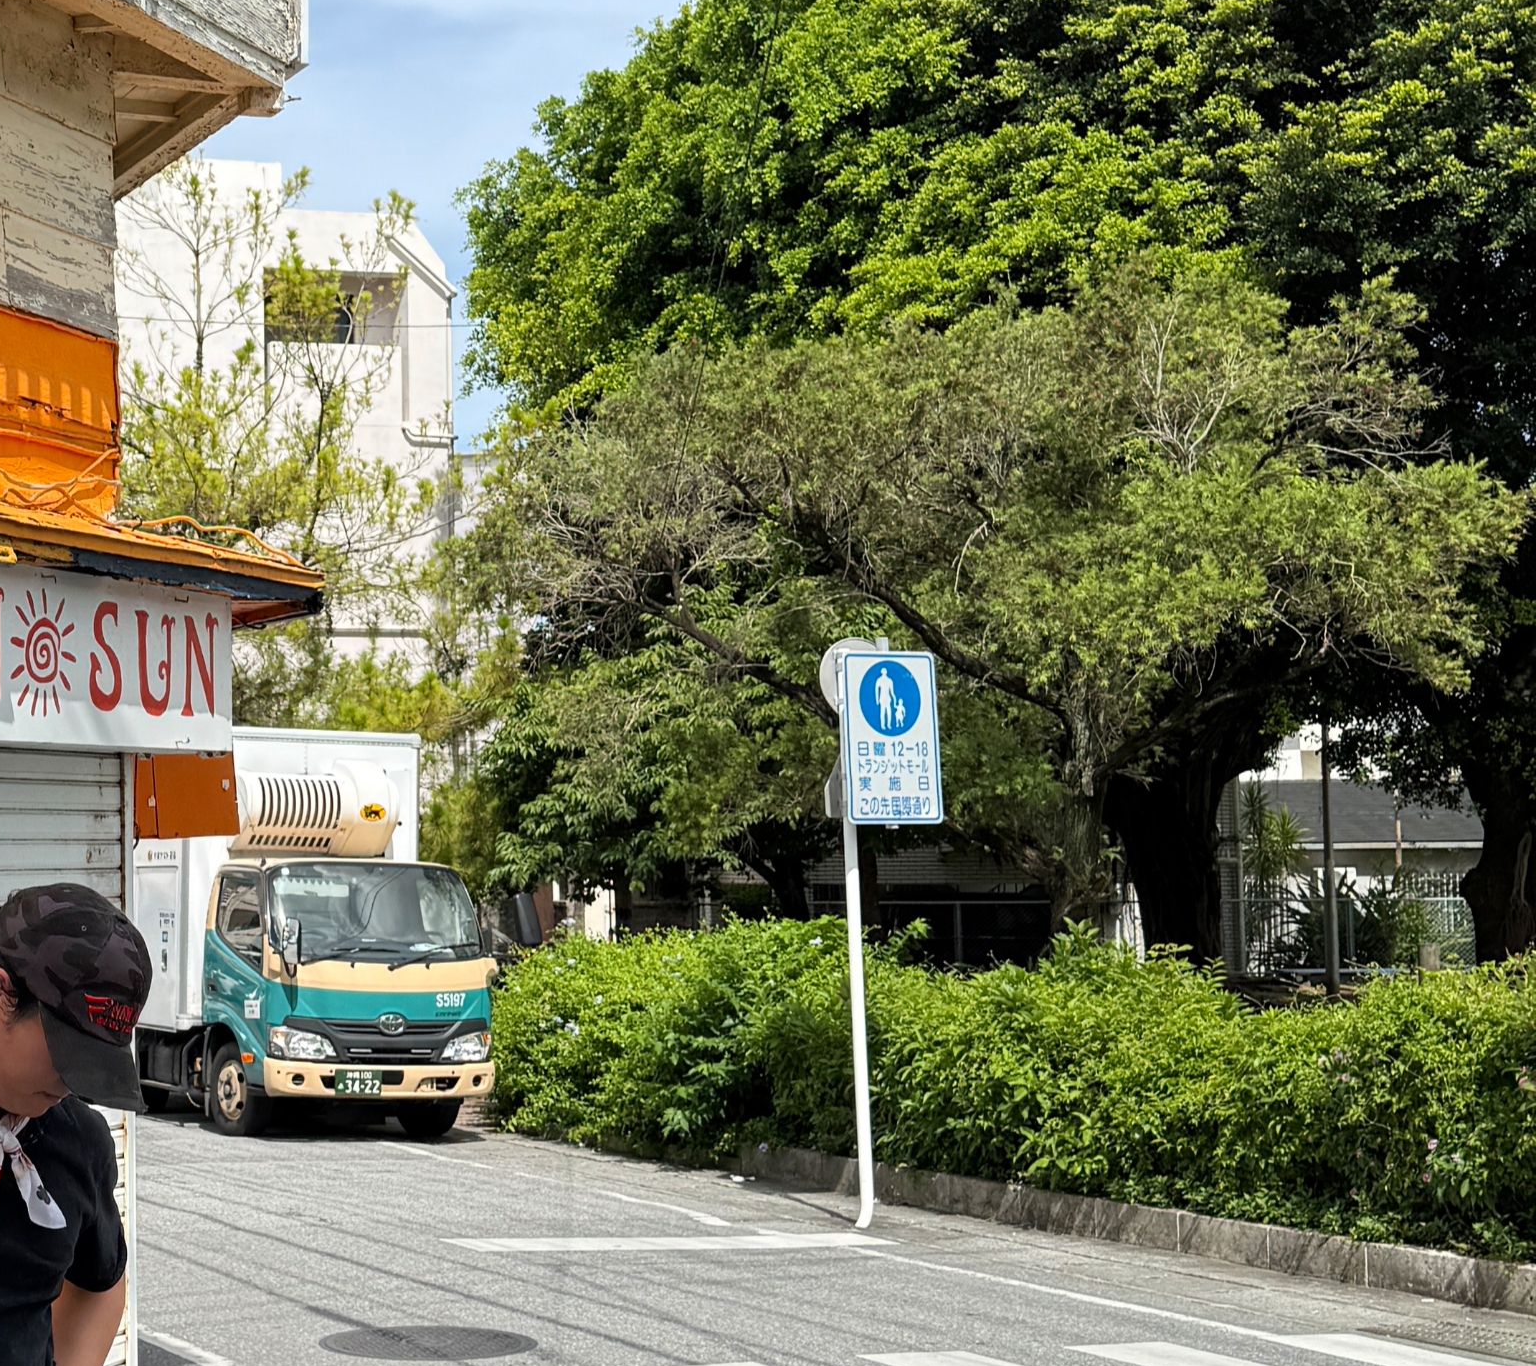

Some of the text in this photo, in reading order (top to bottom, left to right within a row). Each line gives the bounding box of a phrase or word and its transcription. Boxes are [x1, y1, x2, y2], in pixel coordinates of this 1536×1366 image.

[89, 601, 219, 717] SUN
[858, 758, 929, 774] トランジットモール
[858, 776, 930, 791] 実施日
[436, 992, 466, 1007] S5197
[345, 1079, 381, 1094] 34-22
